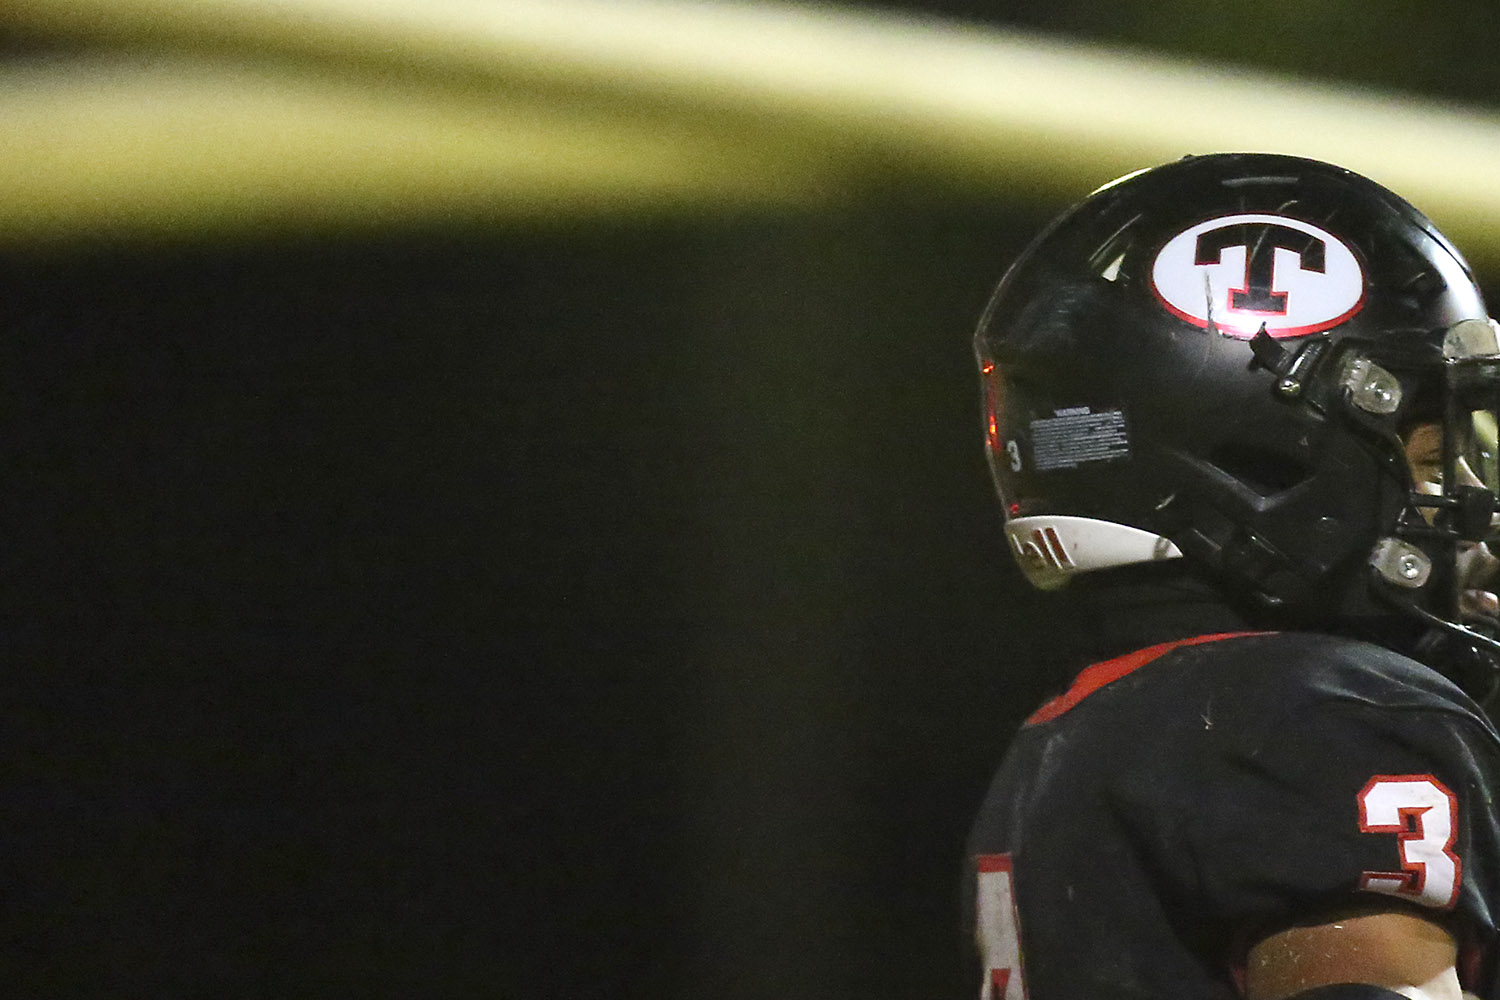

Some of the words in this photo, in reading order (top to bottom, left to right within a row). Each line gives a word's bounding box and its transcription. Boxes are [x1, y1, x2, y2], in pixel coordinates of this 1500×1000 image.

[1194, 222, 1327, 316] T
[1007, 440, 1022, 472] 3
[1356, 774, 1462, 910] 3
